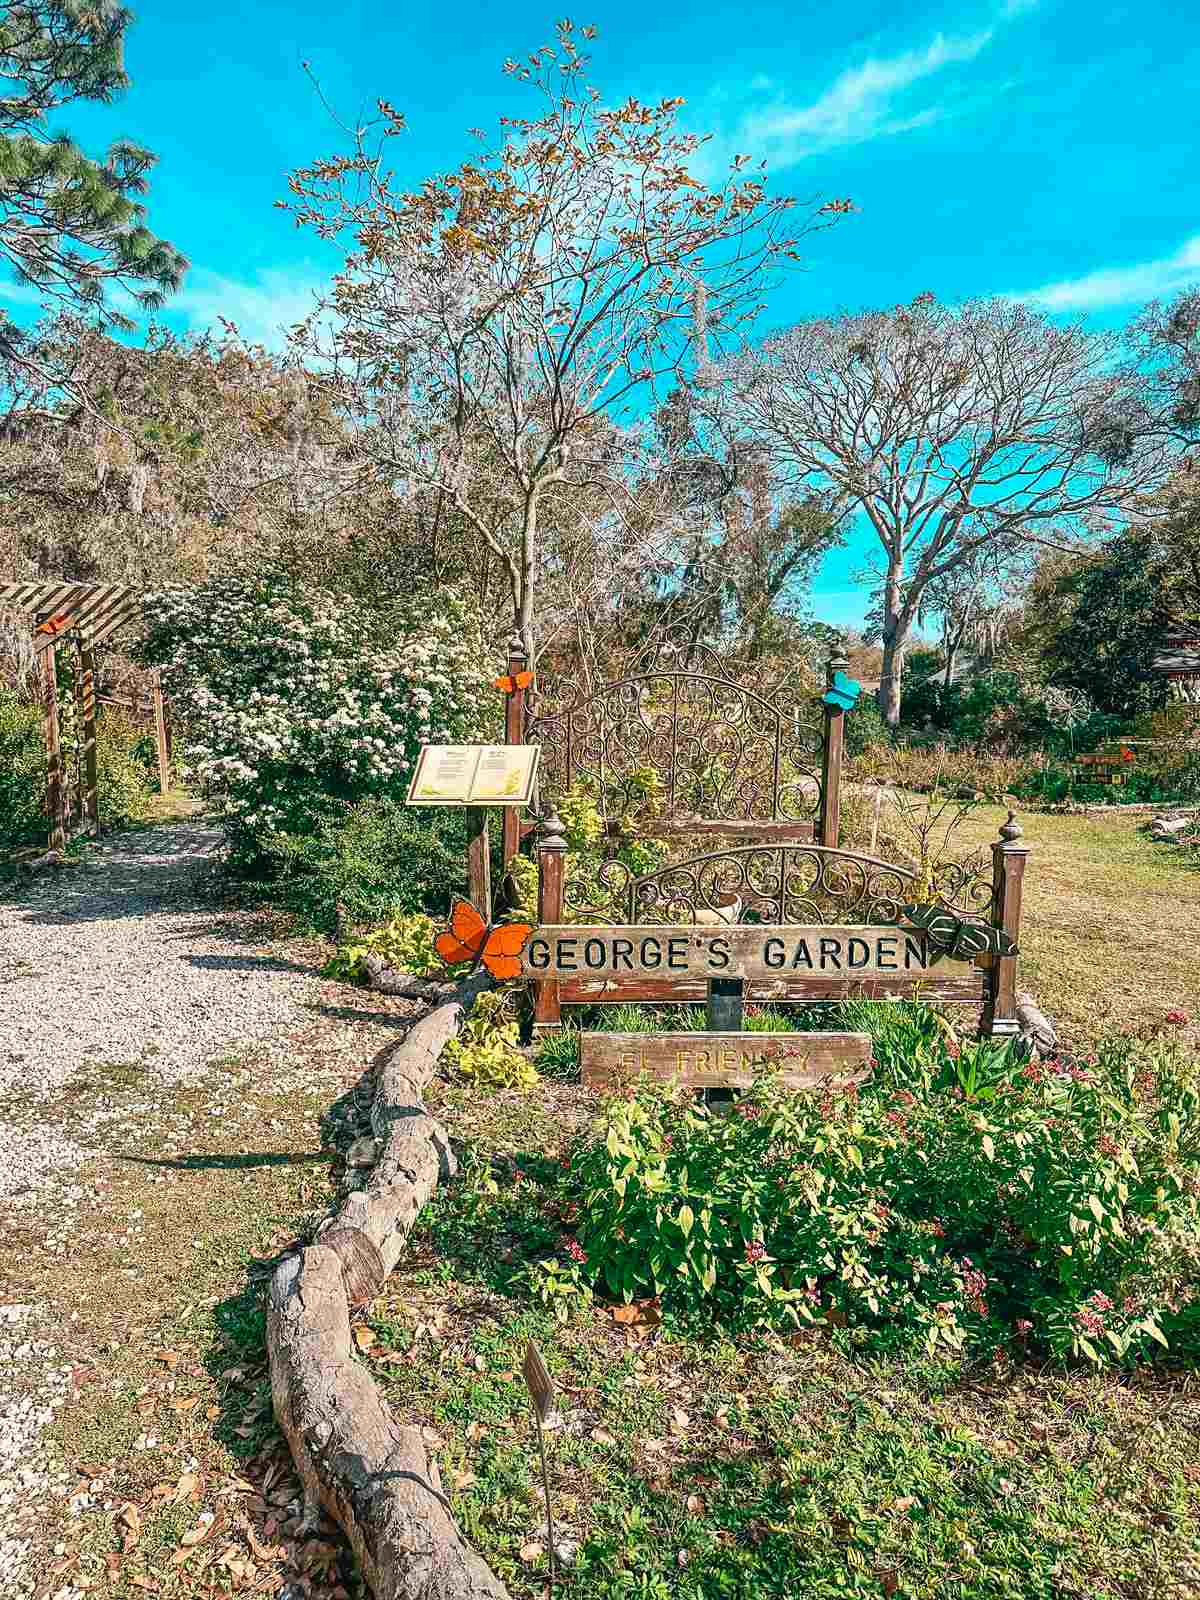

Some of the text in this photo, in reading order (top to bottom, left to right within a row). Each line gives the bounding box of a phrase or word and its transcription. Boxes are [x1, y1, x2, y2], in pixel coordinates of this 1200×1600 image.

[527, 936, 929, 970] GEORGE'S GARDEN
[675, 1049, 810, 1072] FRIENY
